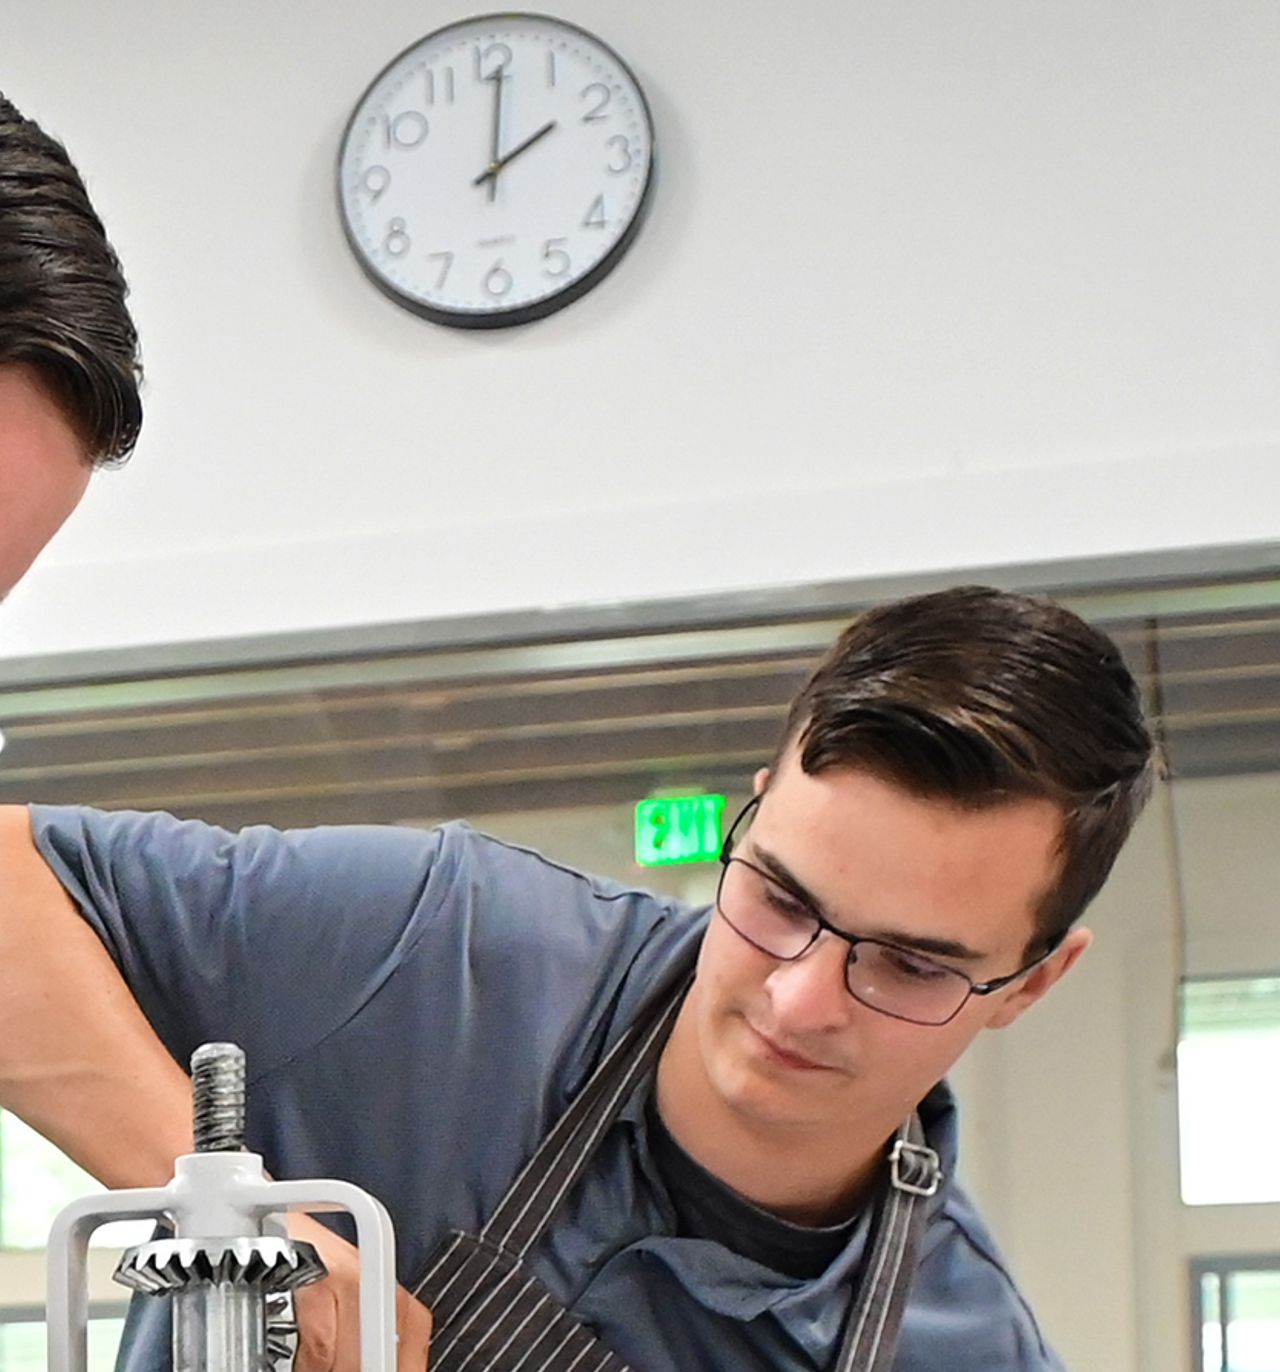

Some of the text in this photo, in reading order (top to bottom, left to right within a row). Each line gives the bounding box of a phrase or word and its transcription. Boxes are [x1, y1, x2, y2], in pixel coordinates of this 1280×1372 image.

[472, 42, 513, 83] 12
[546, 50, 556, 88] 1
[425, 66, 455, 105] 11
[579, 82, 612, 124] 2
[383, 110, 430, 149] 10
[605, 134, 632, 174] 3
[362, 165, 391, 203] 9
[582, 194, 607, 230] 4
[384, 216, 412, 257] 8
[428, 251, 455, 290] 7
[543, 237, 571, 278] 5
[483, 258, 513, 297] 6
